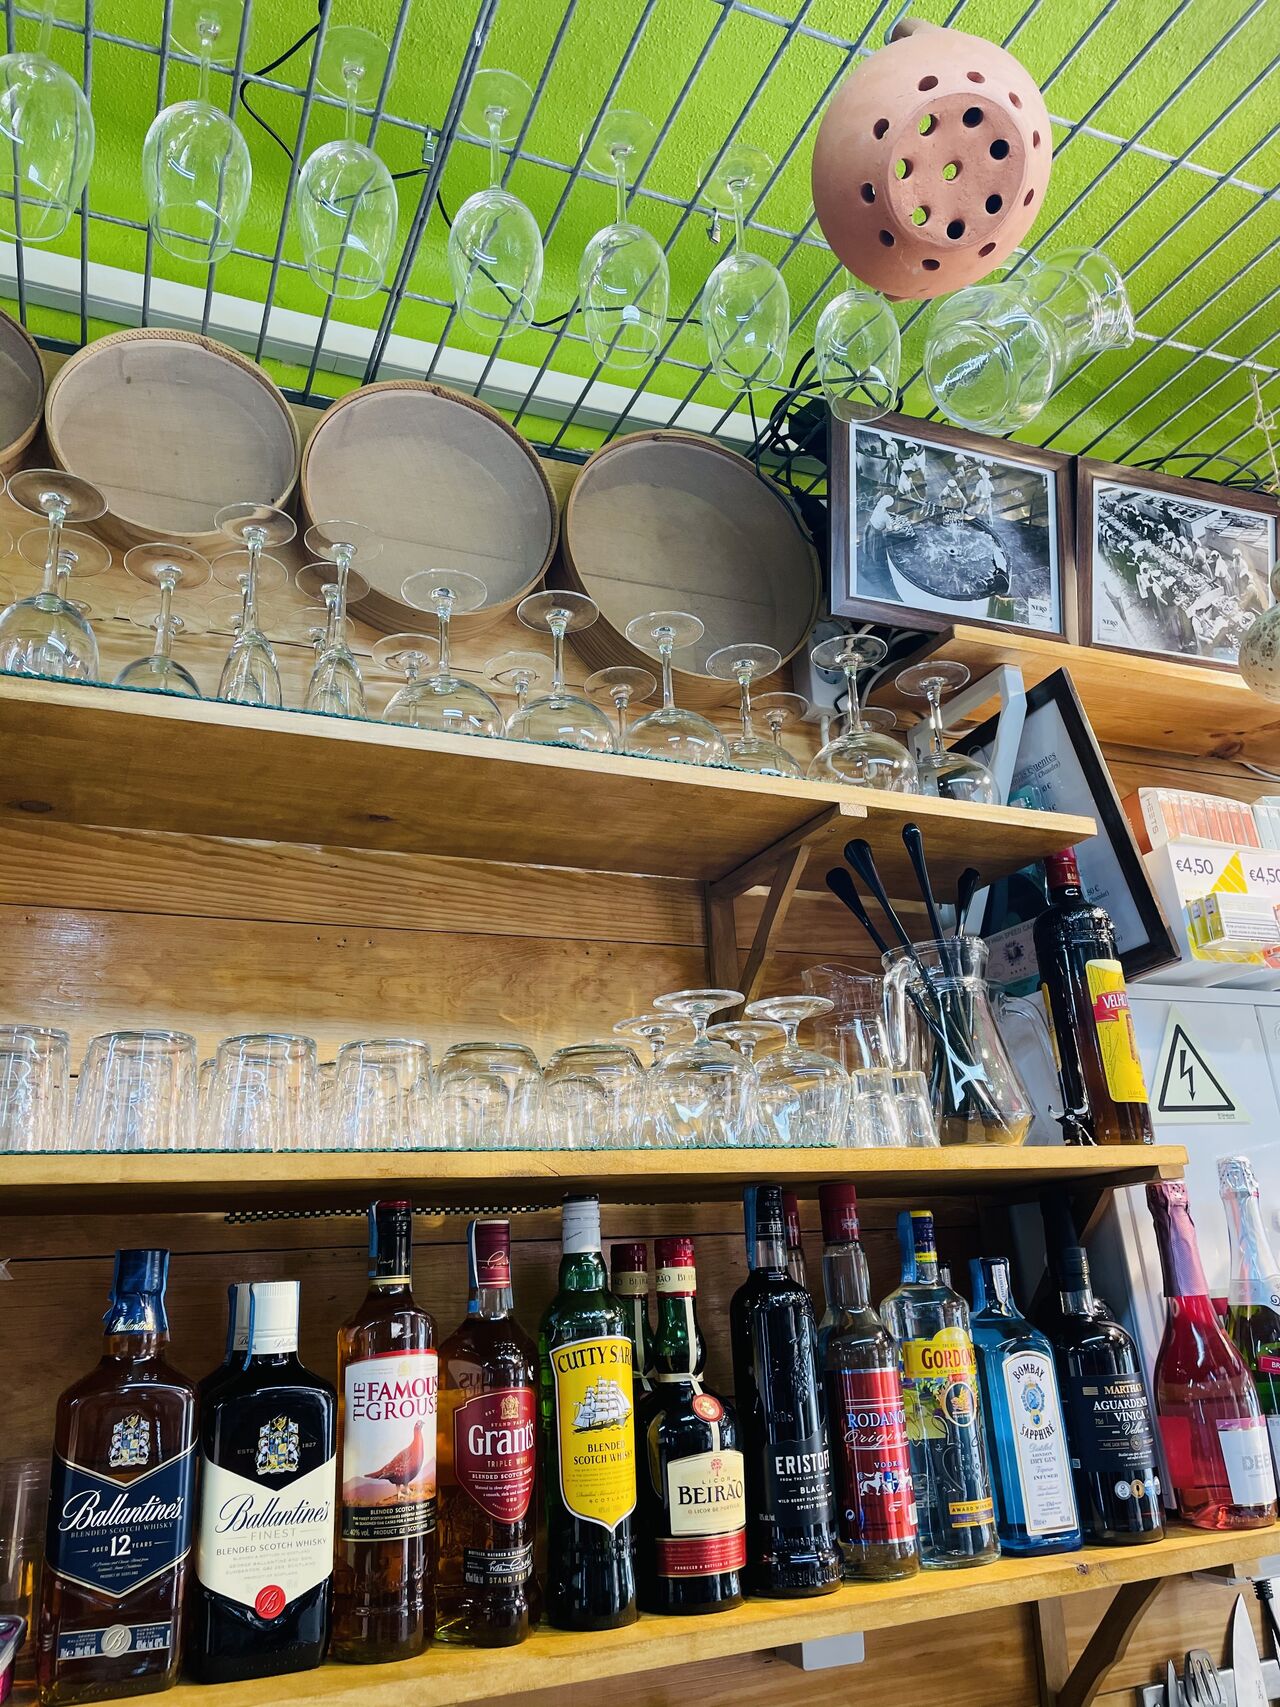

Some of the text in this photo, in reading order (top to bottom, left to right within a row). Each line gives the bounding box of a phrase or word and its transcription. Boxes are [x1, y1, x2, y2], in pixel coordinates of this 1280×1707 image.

[1031, 604, 1048, 613] NERO
[1102, 618, 1118, 627] NERO
[1145, 797, 1159, 834] HEETS
[1176, 858, 1214, 876] €4,50
[557, 1346, 608, 1374] CUTTY
[1012, 1363, 1045, 1380] BOMBAY
[353, 1382, 365, 1421] THE
[1114, 1409, 1145, 1422] VÍNICA
[468, 1419, 534, 1456] Grant's
[1020, 1423, 1055, 1440] SAPPHIRE
[487, 1459, 512, 1468] TRIPLE
[573, 1455, 607, 1465] SCOTCH
[500, 1471, 523, 1480] SCOTCH
[702, 1476, 731, 1485] LICOR
[678, 1480, 743, 1505] BEIRÃO
[800, 1483, 825, 1494] BLACK
[58, 1489, 183, 1531] Ballantine's
[215, 1493, 330, 1533] Ballantine's
[395, 1505, 414, 1513] SCOTCH
[70, 1521, 174, 1539] BLENDED SCOTCH WHISKY
[250, 1528, 297, 1541] FINEST
[373, 1528, 397, 1536] PRODUCT
[110, 1534, 131, 1557] 12
[132, 1541, 152, 1549] YEARS
[216, 1537, 327, 1556] BLENDED SCOTCH WHISKY
[489, 1575, 513, 1584] STAND
